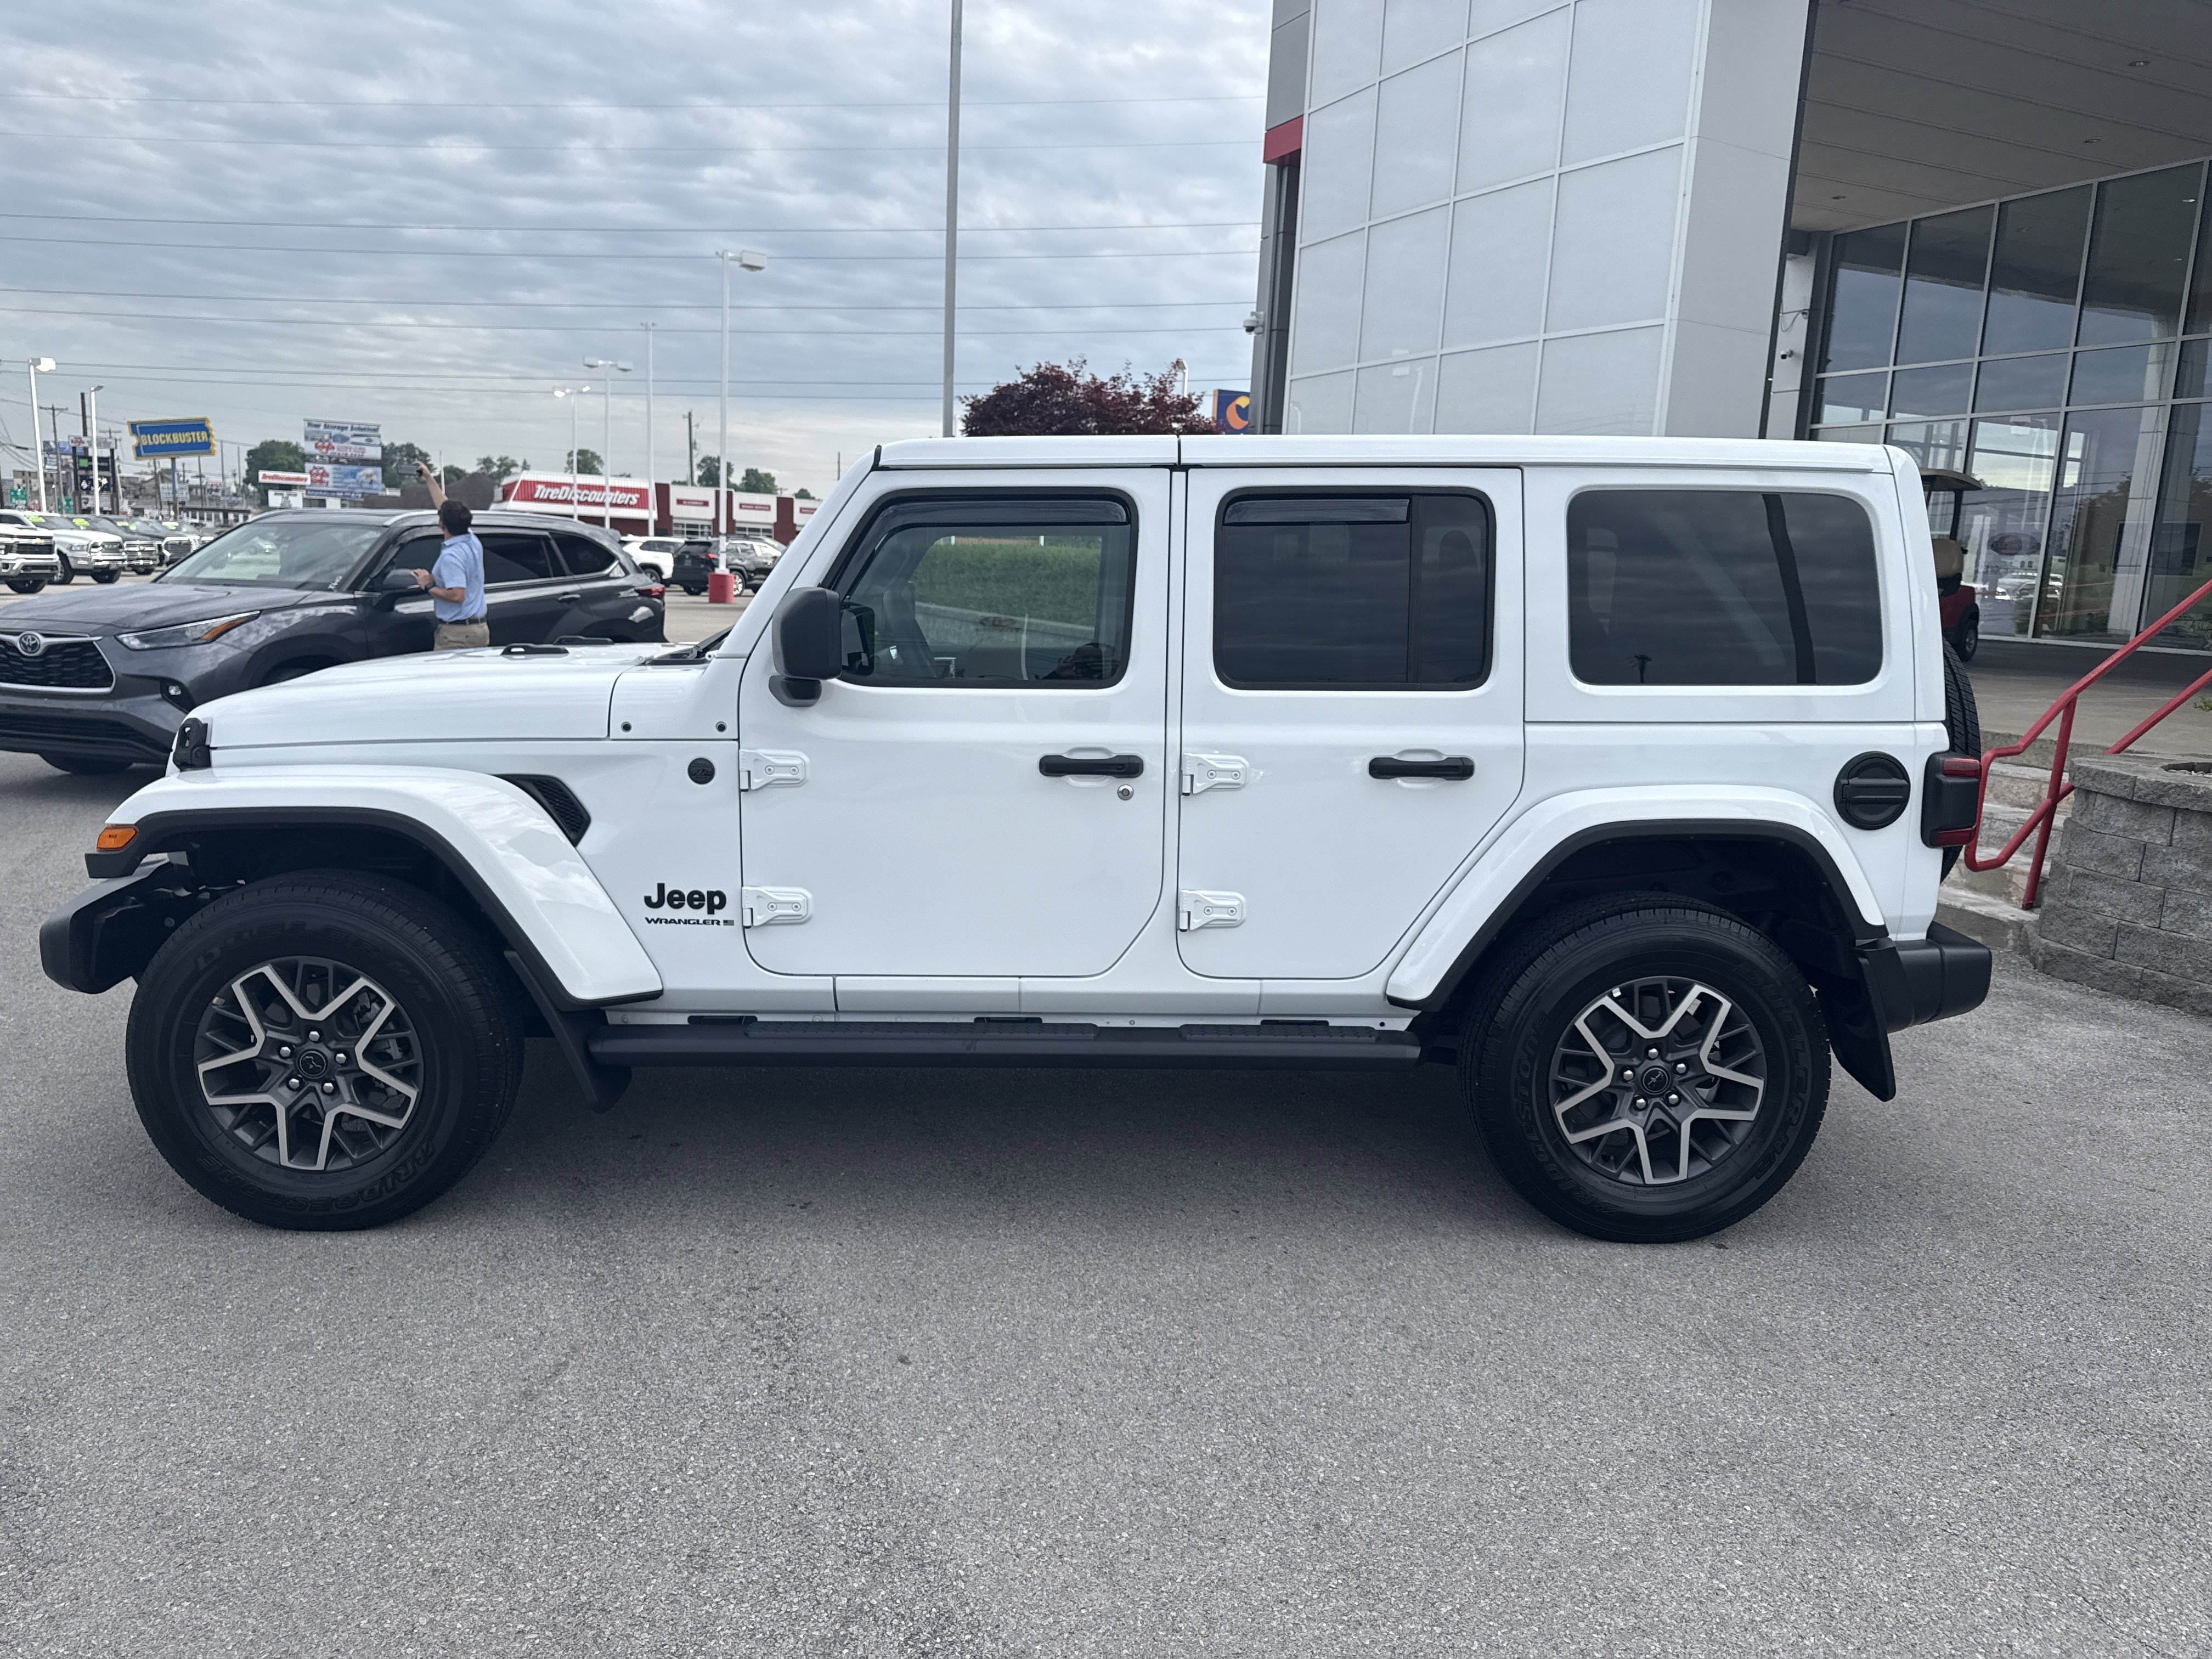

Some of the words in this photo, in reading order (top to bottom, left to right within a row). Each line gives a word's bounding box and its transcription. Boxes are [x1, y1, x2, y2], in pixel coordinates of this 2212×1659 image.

[140, 431, 208, 445] BLOCKBUSTER
[644, 883, 727, 915] Jeep
[644, 917, 721, 926] WRANGLER
[1515, 1009, 1621, 1217] BRIDGESTONE
[196, 1141, 437, 1212] BRIDGESTONE
